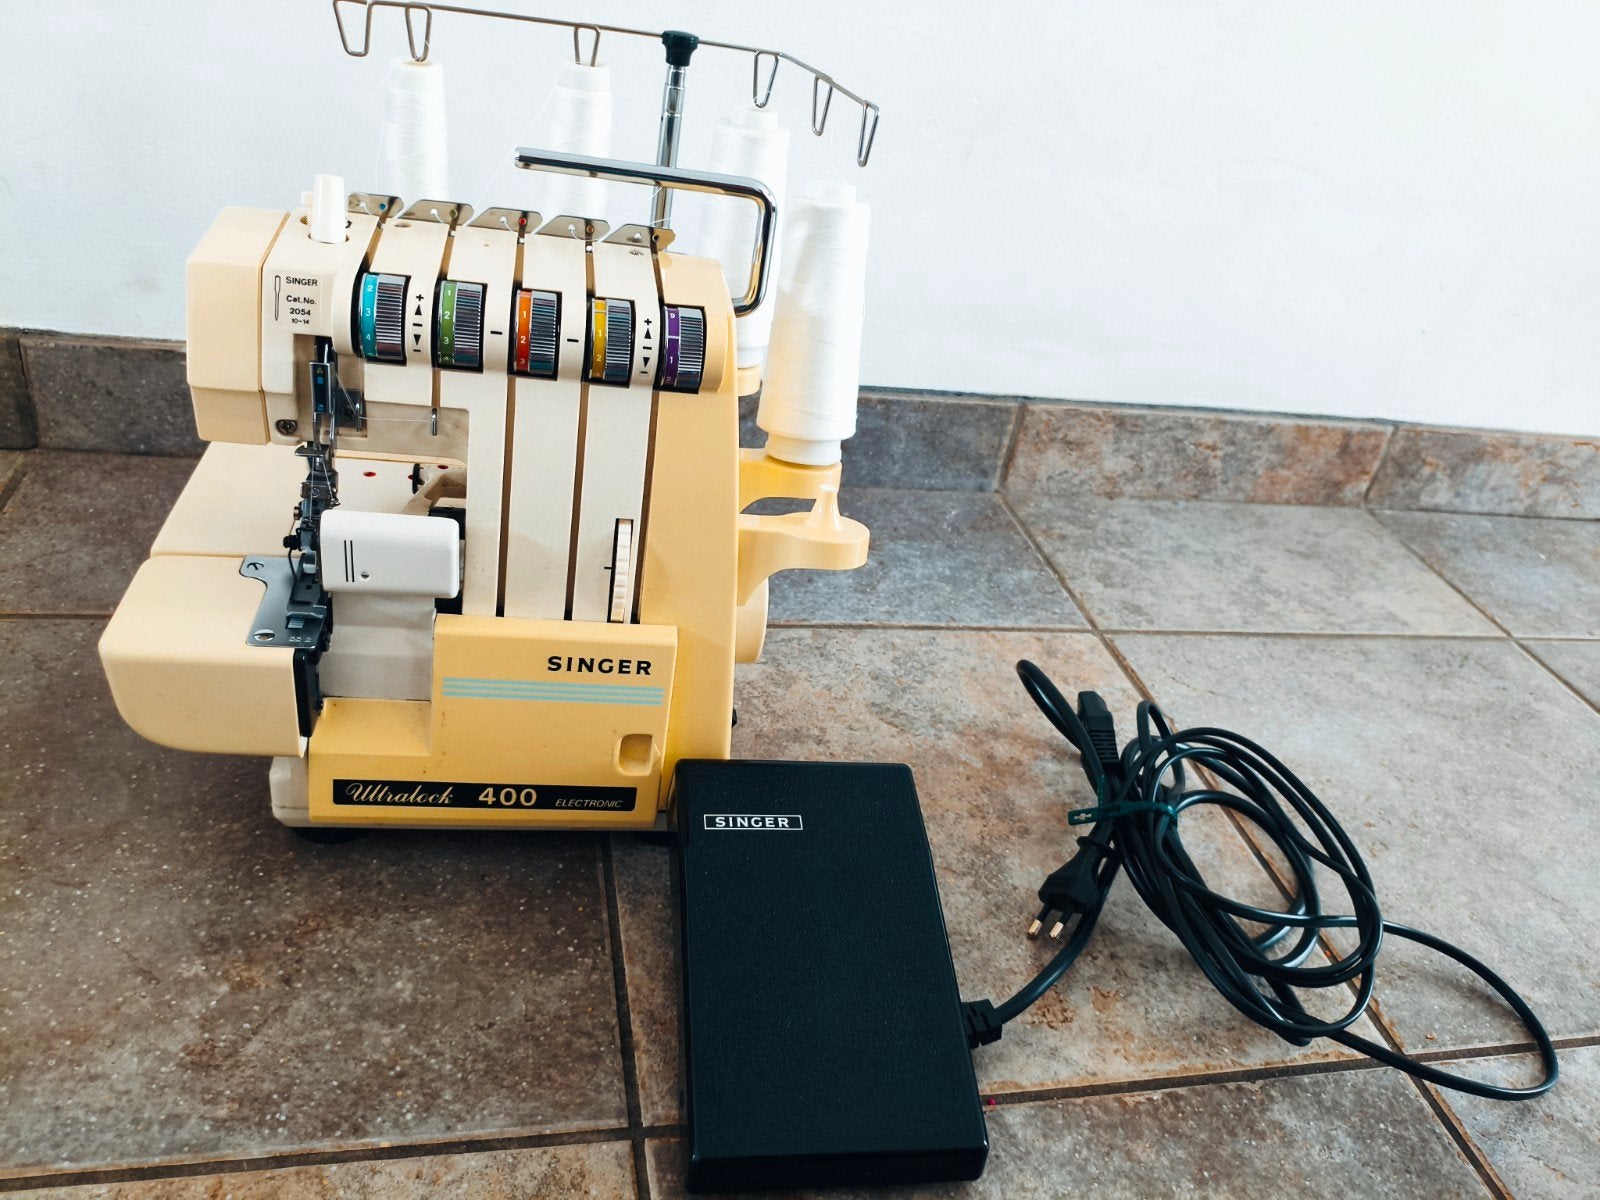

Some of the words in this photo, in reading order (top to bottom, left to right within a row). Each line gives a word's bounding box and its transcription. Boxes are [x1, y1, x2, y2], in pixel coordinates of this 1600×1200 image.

[285, 276, 318, 286] SINGER
[289, 307, 311, 316] 2054
[365, 307, 371, 316] 3
[444, 311, 450, 320] 2
[366, 333, 371, 341] 4
[443, 336, 449, 345] 3
[520, 335, 526, 344] 2
[547, 655, 652, 675] SINGER
[345, 782, 454, 804] Ultralock
[478, 787, 537, 806] 400
[555, 798, 623, 808] ELECTRONIC
[715, 816, 790, 828] SINGER
